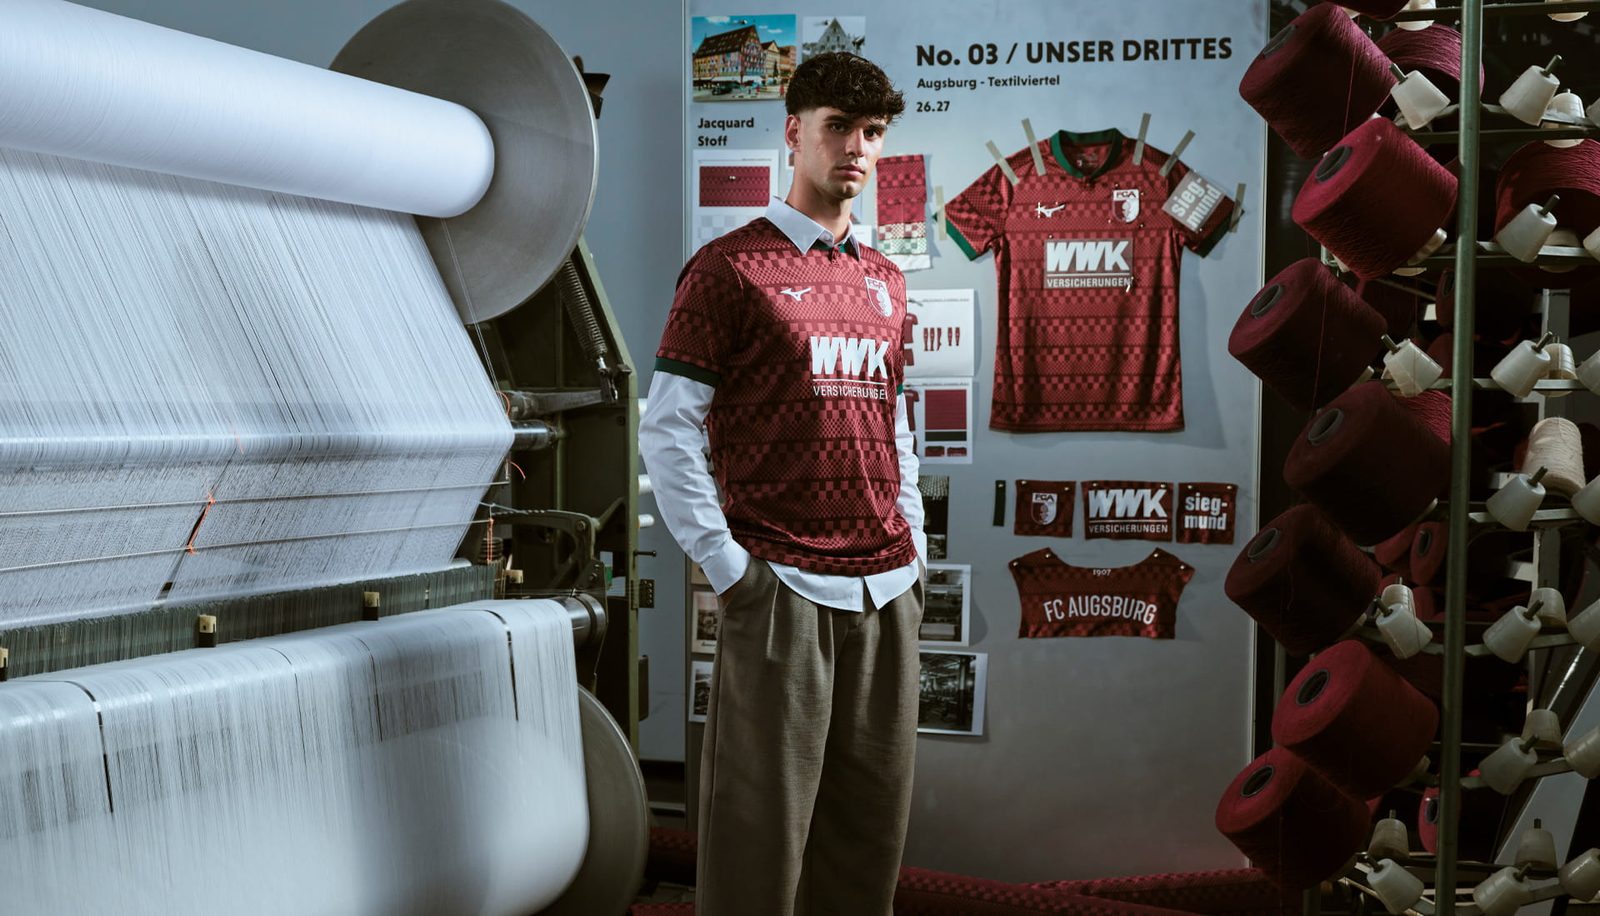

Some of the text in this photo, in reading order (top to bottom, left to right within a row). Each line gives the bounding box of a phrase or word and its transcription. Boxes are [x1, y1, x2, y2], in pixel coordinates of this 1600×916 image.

[916, 37, 1233, 66] No. 03 / UNSER DRITTES
[917, 78, 977, 90] Augsburg
[988, 75, 1060, 87] Textilviertel
[916, 101, 950, 112] 26.27
[698, 117, 754, 131] Jacquard
[698, 135, 727, 146] Stoff
[1116, 191, 1137, 199] FCA
[1187, 185, 1221, 228] mund
[1046, 240, 1130, 272] WWK
[1047, 277, 1131, 288] VERSICHERUNGEN
[810, 336, 889, 379] WWK
[1035, 493, 1054, 501] FCA
[1088, 488, 1168, 518] WWK
[1184, 492, 1228, 516] sieg-
[1088, 523, 1168, 534] VERSICHERUNGEN
[1184, 513, 1227, 530] mund
[1043, 595, 1157, 624] FC AUGSBURG
